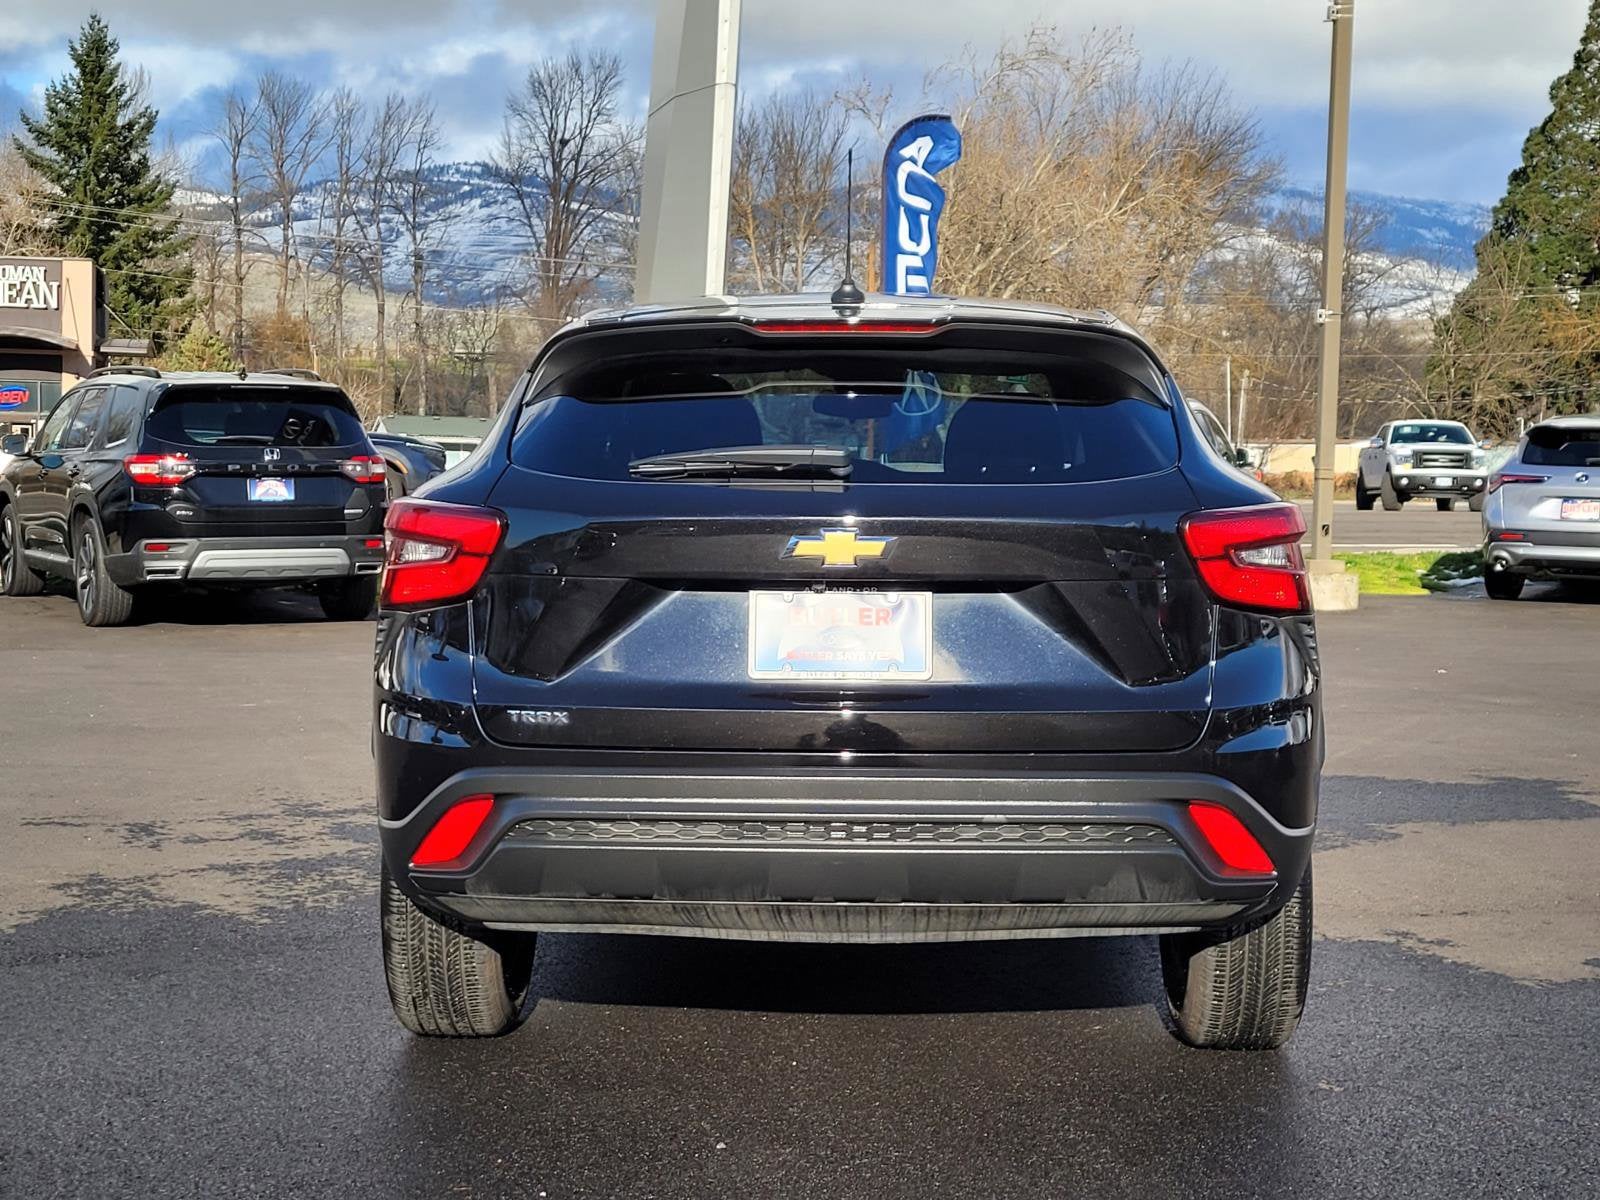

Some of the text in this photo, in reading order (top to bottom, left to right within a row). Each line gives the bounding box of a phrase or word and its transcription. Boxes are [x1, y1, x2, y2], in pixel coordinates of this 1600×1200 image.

[0, 390, 30, 403] PEN
[227, 463, 319, 472] PILOT
[507, 709, 569, 725] TRAX
